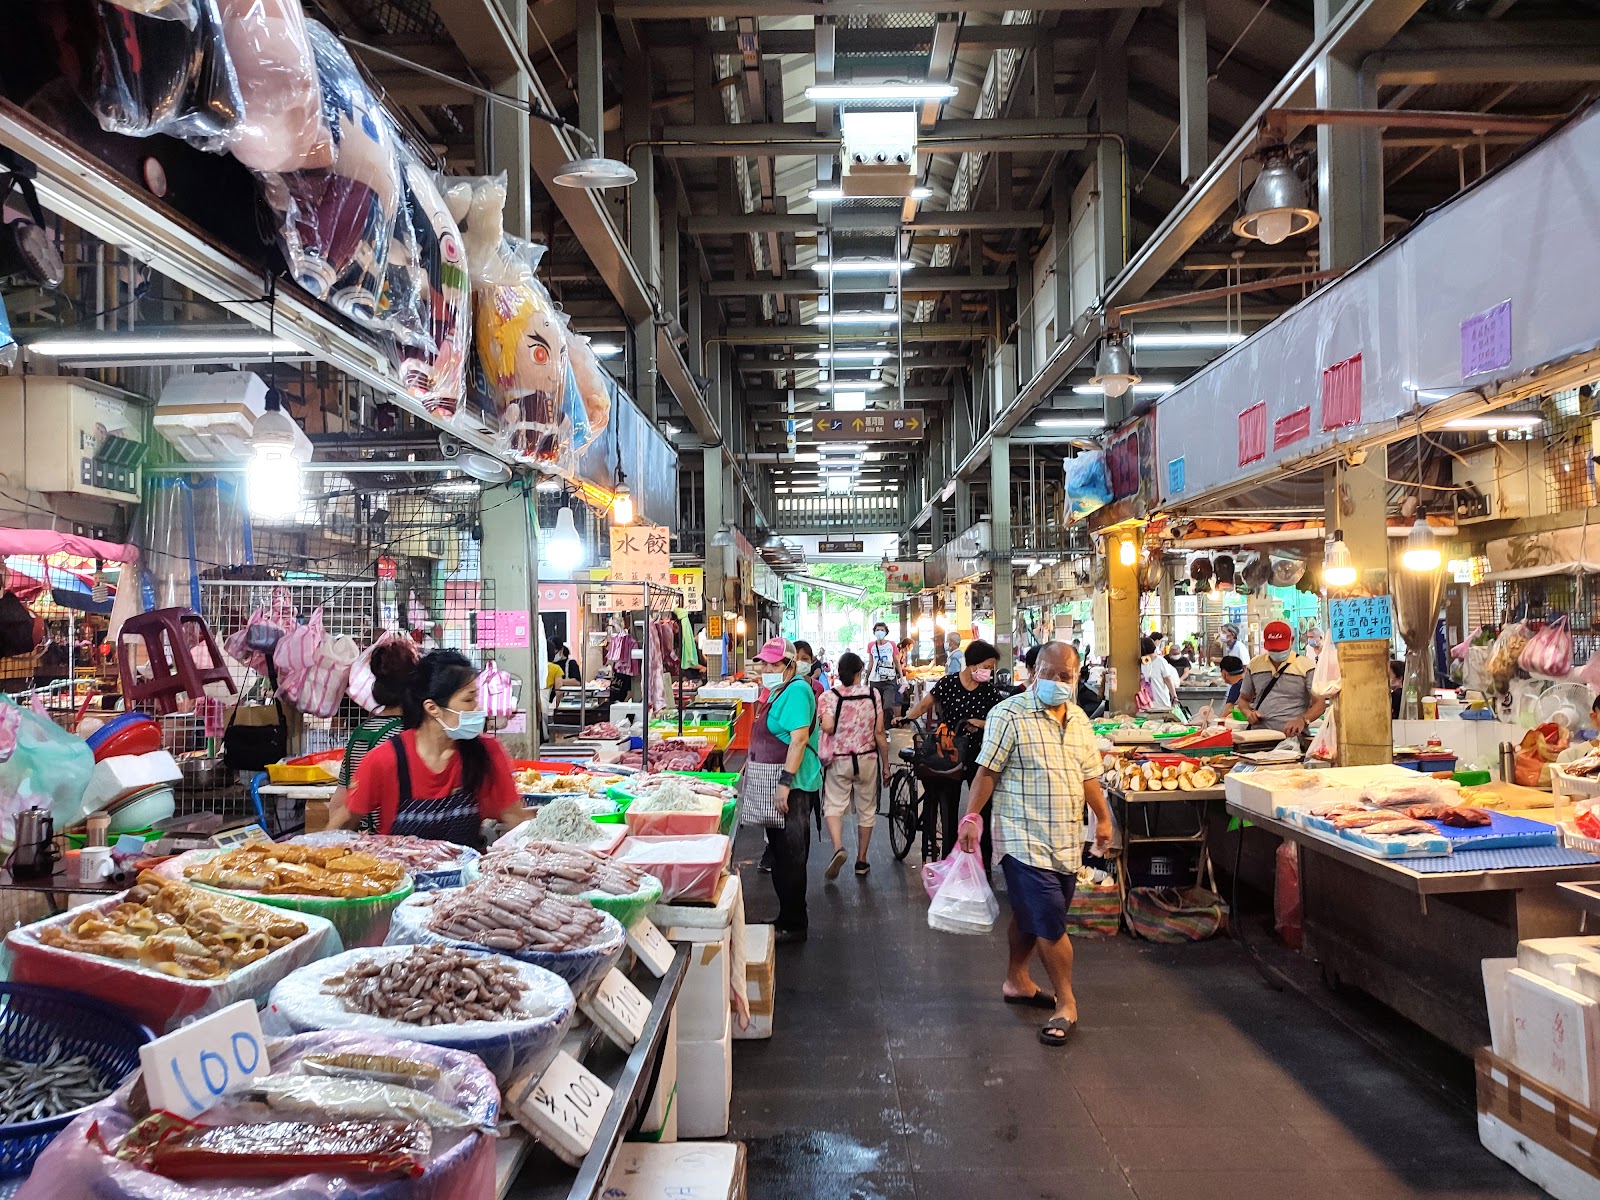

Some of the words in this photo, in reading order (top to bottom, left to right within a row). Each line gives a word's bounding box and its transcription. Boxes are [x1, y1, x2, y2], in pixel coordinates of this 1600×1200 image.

[614, 532, 668, 555] 水餃
[1337, 626, 1391, 639] 美國牛肉
[170, 1031, 259, 1111] 100
[563, 1074, 600, 1118] 100
